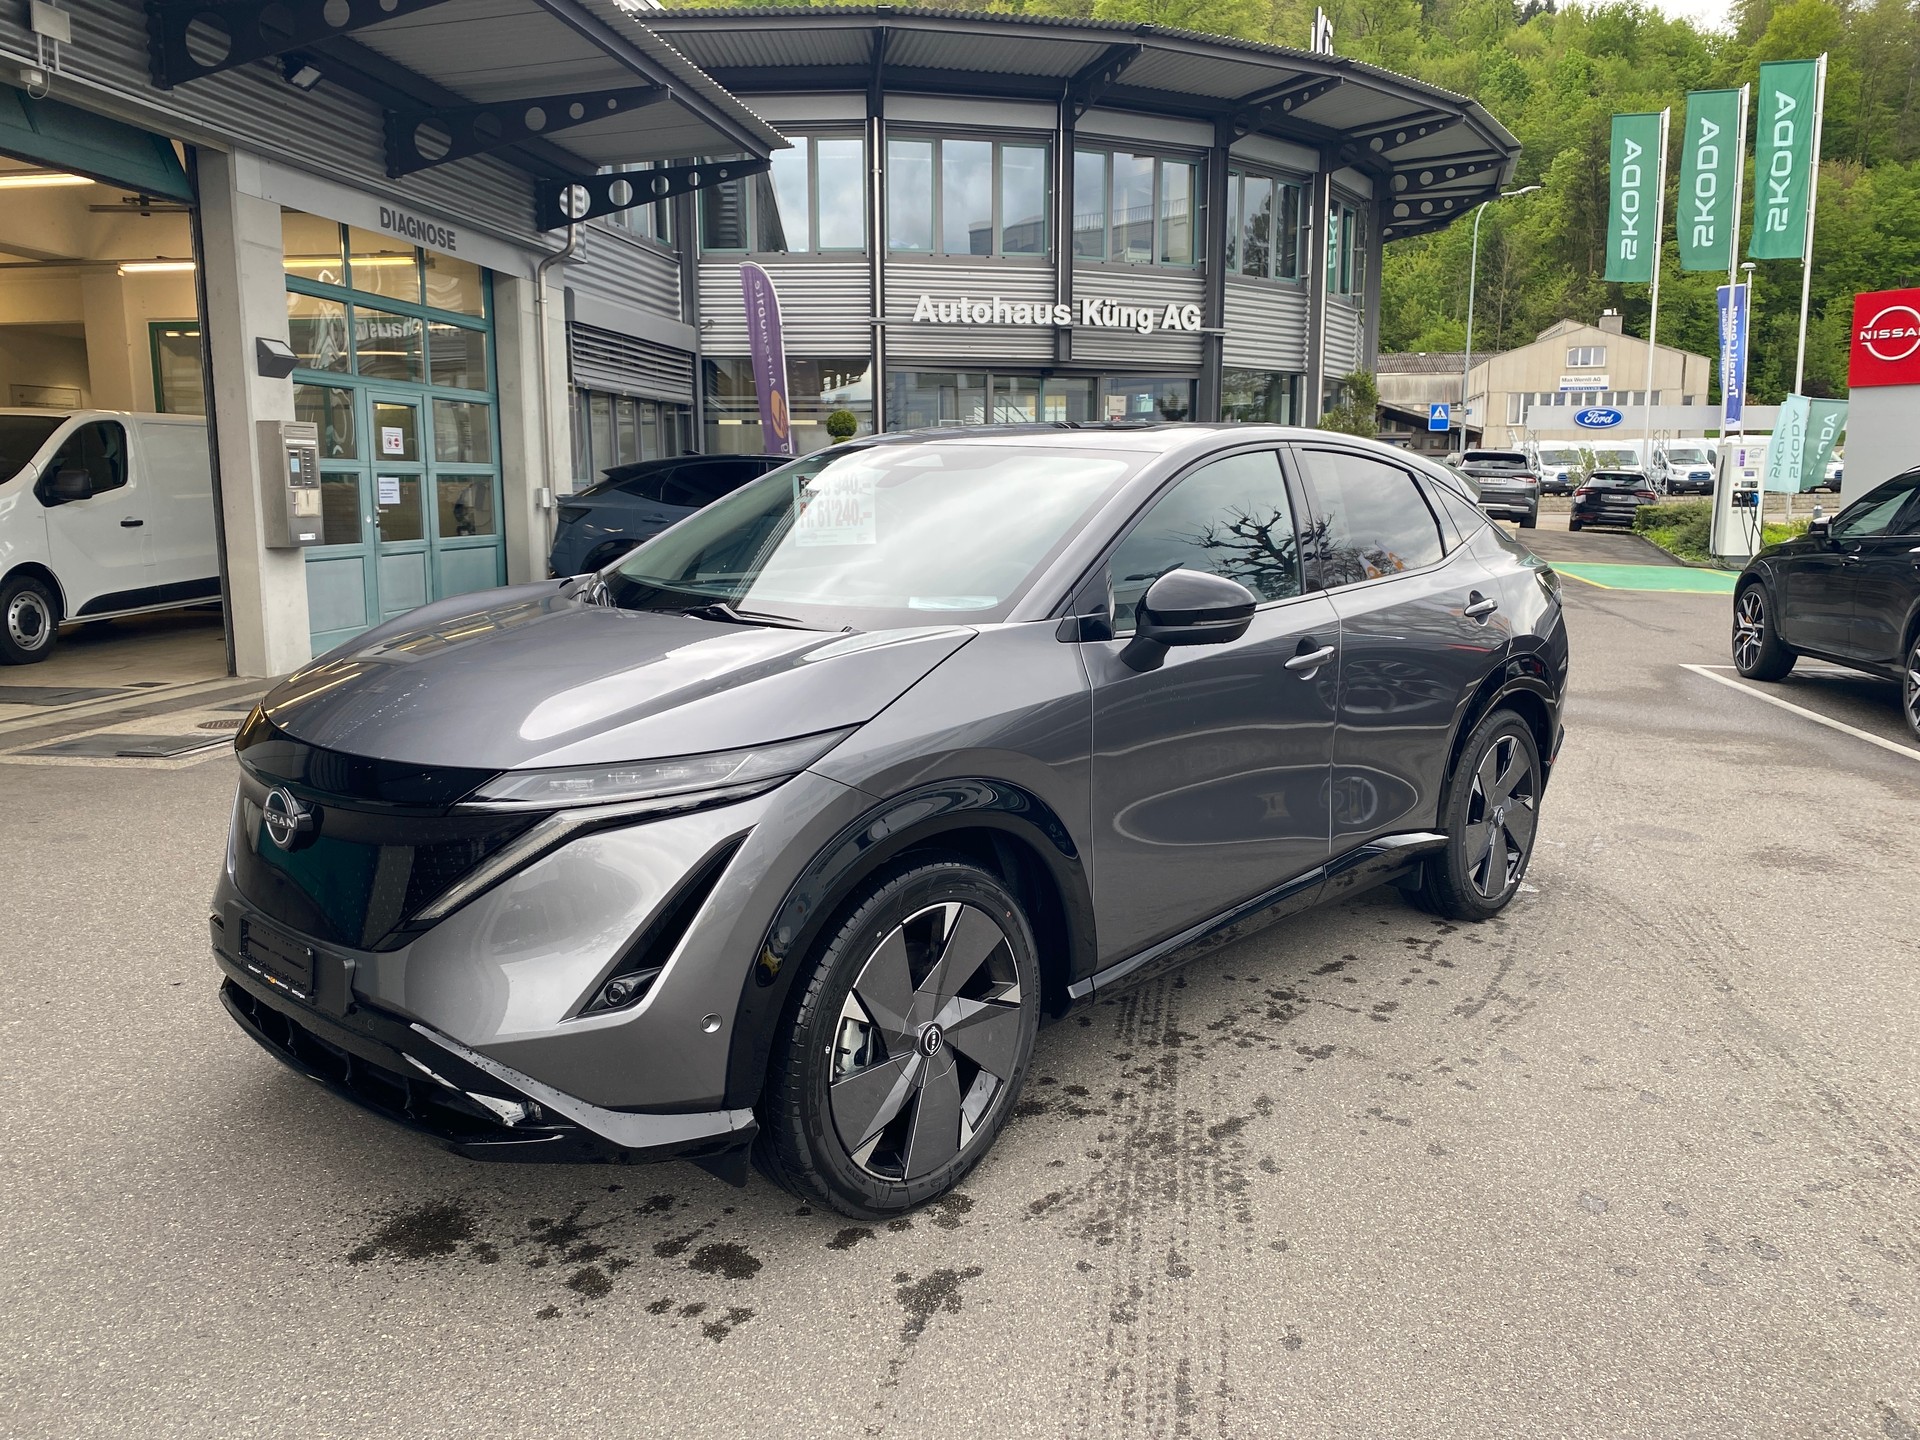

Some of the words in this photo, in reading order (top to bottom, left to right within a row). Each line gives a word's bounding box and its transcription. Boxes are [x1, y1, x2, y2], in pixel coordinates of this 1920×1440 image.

[379, 206, 457, 252] DIAGNOSE
[912, 295, 1072, 325] Autohaus
[1080, 298, 1154, 334] Küng
[1160, 303, 1202, 331] AG
[1584, 409, 1614, 424] Ford
